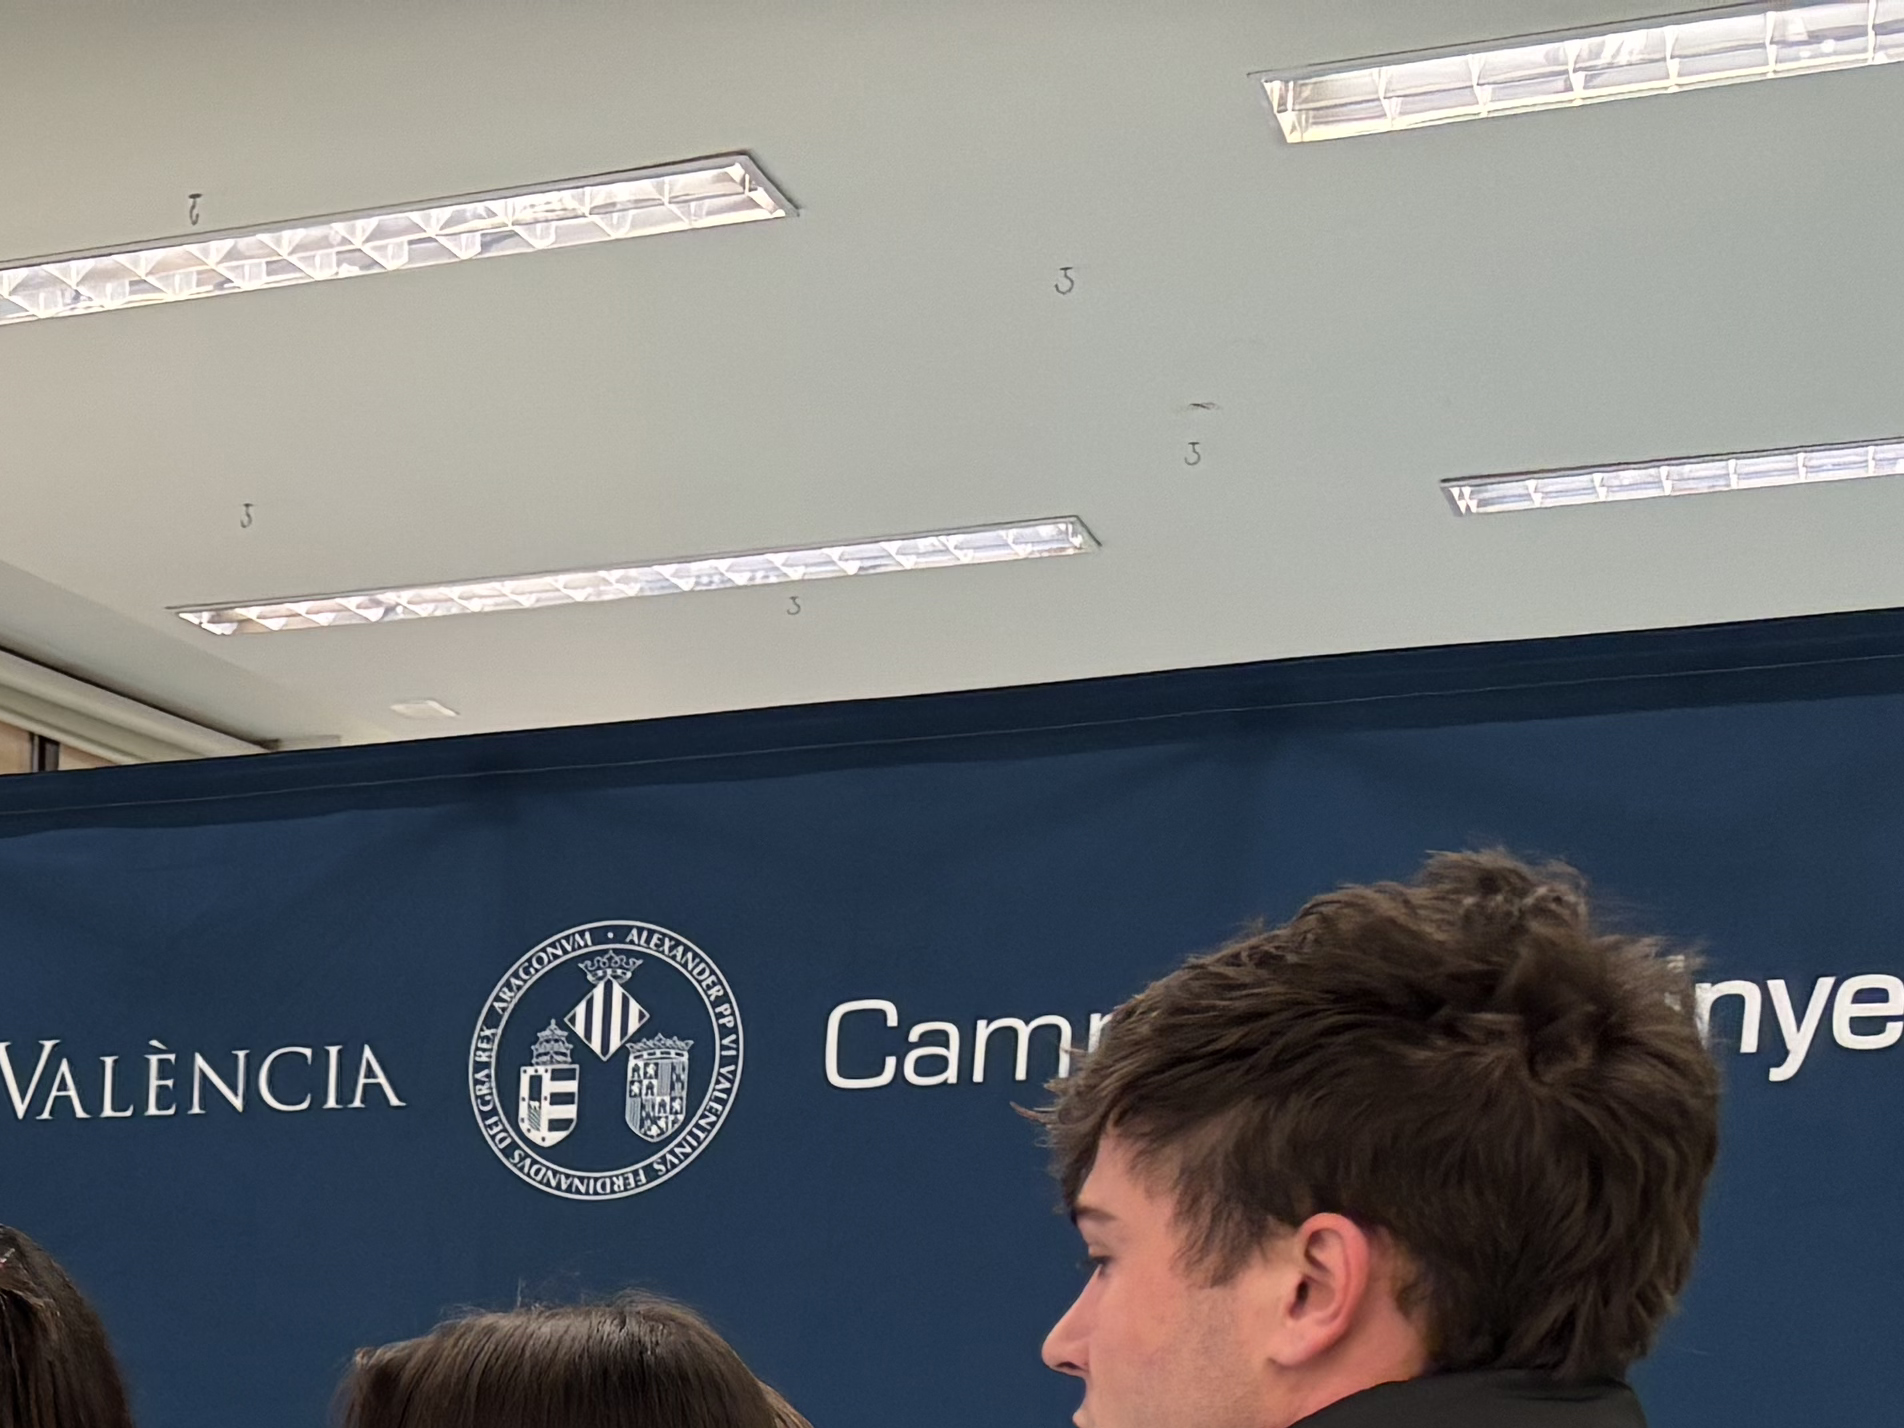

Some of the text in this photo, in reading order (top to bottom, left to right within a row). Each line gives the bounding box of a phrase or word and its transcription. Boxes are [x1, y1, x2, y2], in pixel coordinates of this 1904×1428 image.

[491, 930, 592, 1016] ARAGONVM
[625, 927, 724, 1002] ALEXANDER
[1666, 956, 1904, 1082] nye
